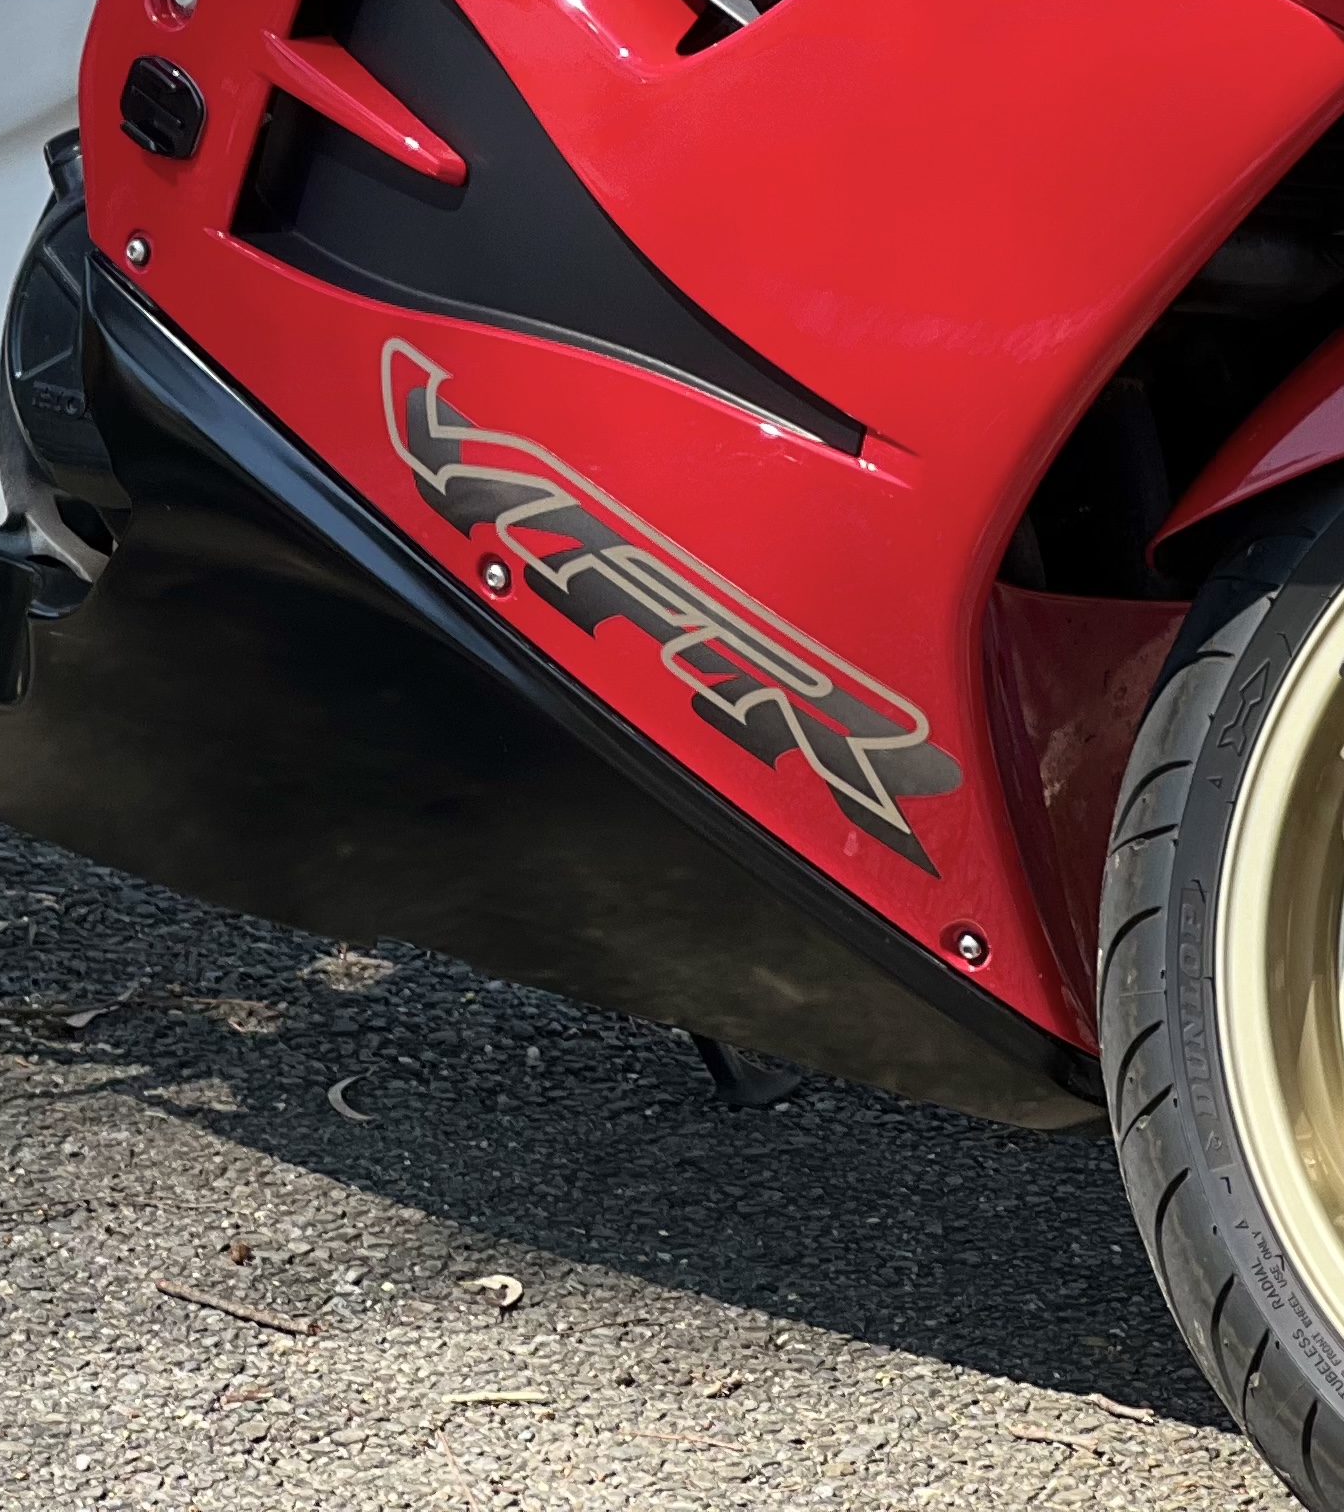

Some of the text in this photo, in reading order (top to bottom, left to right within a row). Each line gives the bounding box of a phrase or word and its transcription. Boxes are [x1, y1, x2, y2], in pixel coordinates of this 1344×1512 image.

[381, 336, 963, 878] VFR
[1251, 1231, 1272, 1260] ONLY
[1251, 1256, 1285, 1310] RADIAL
[1269, 1264, 1288, 1289] USE
[1287, 1291, 1313, 1329] WHEEL
[1313, 1332, 1342, 1367] FRONT
